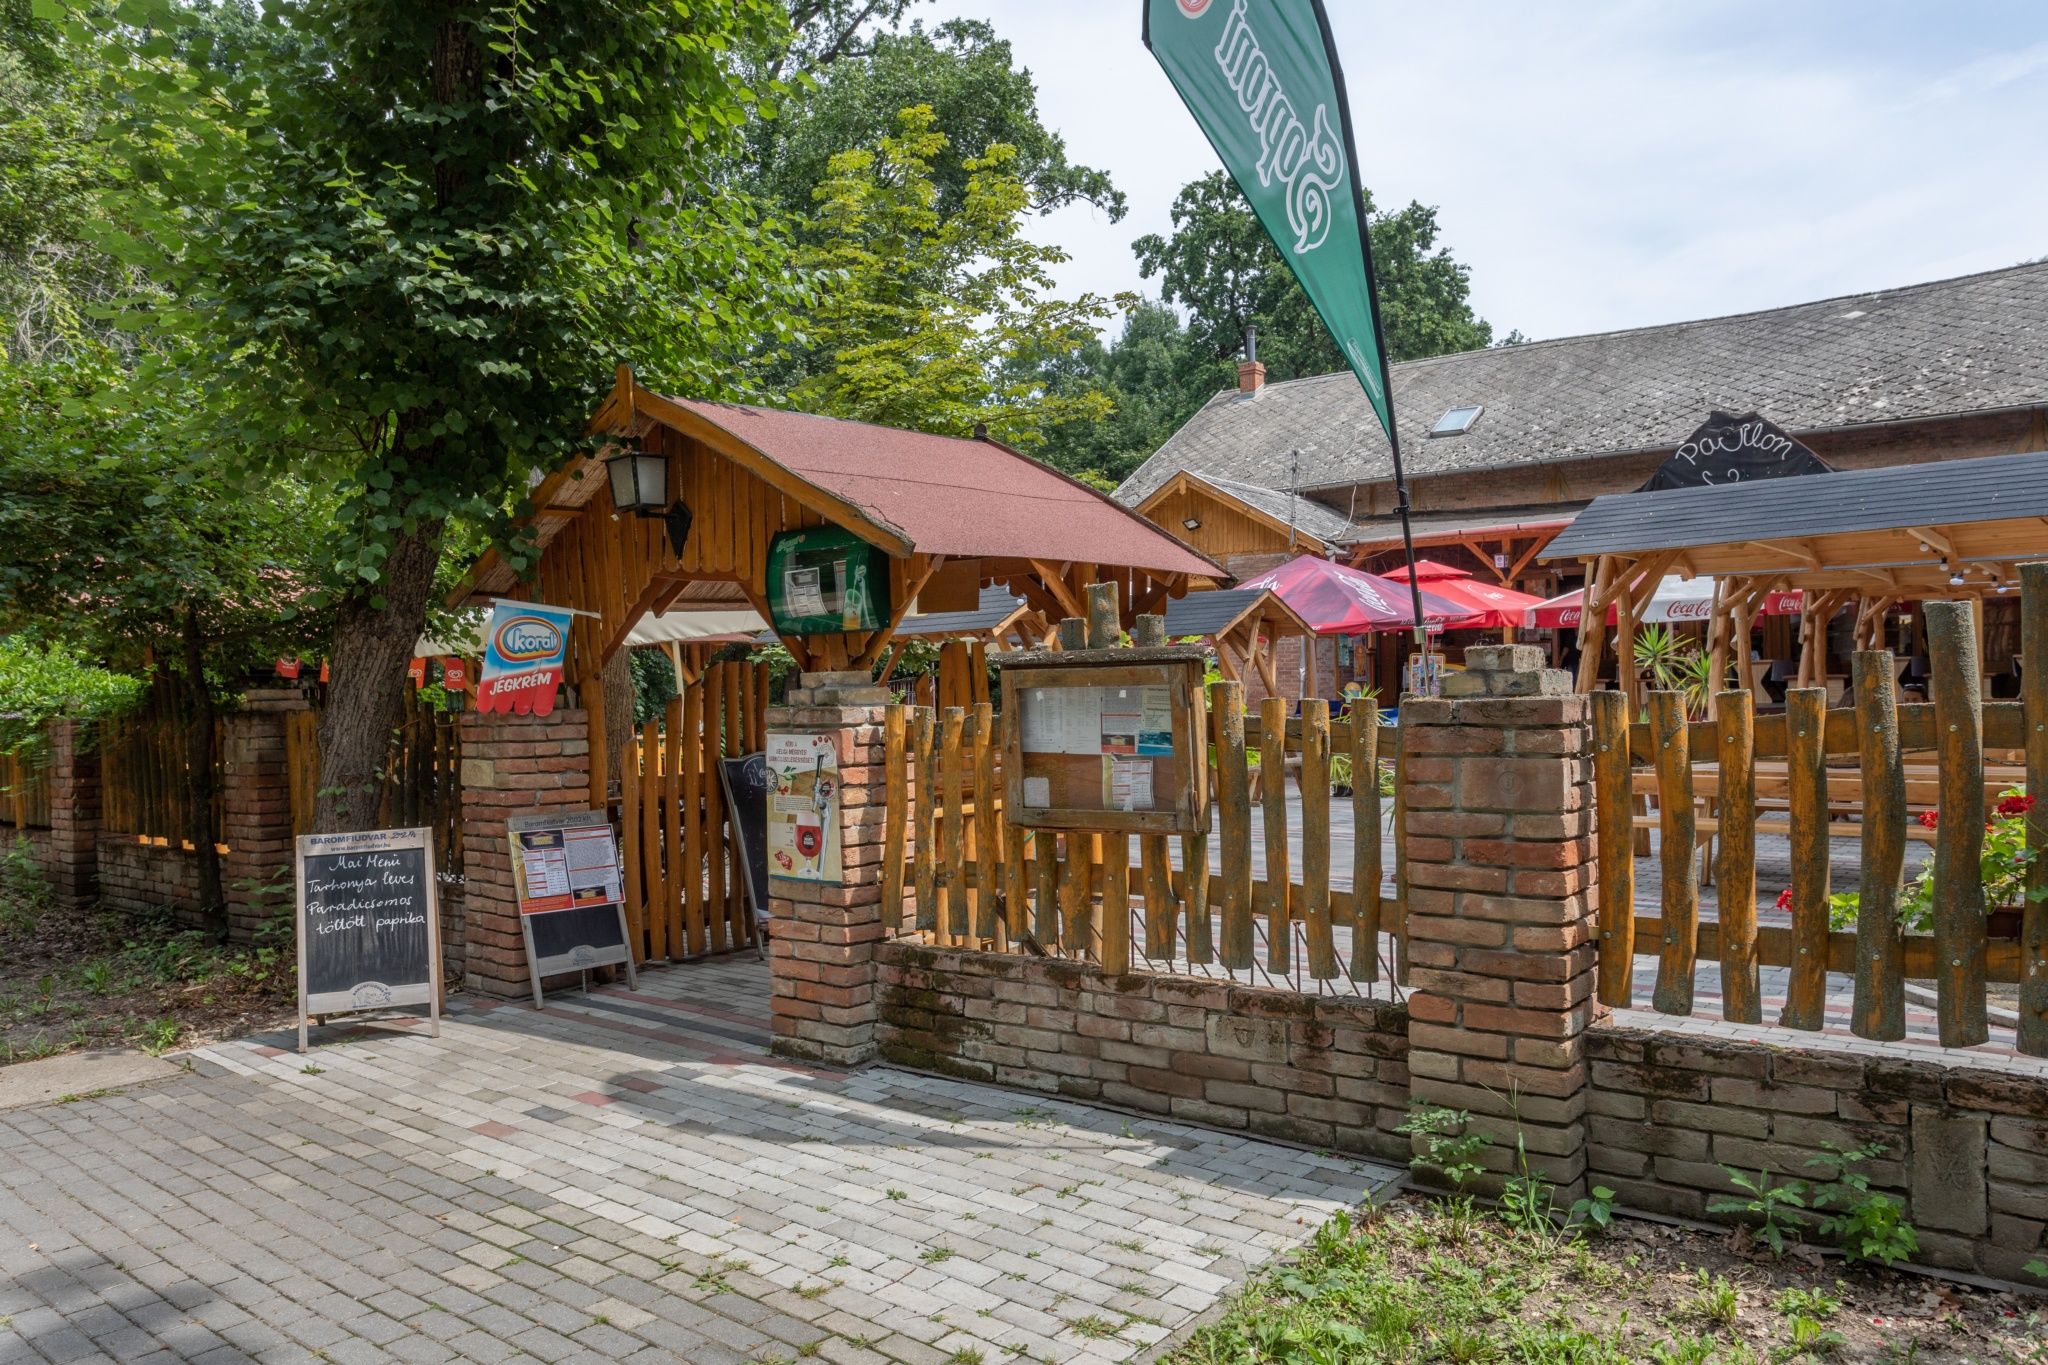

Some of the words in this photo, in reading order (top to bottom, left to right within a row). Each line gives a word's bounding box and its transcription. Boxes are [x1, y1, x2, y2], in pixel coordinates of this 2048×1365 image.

[1559, 608, 1581, 626] Coca
[1666, 599, 1711, 618] Coca-Co
[489, 670, 553, 696] JÉGKRÉM
[310, 833, 387, 845] BAROMFIUDVAR
[329, 856, 362, 871] Mai
[366, 854, 401, 868] Menü
[307, 878, 377, 893] Tarhonya
[382, 871, 415, 885] leves
[306, 896, 413, 915] Paradicsomos
[376, 912, 426, 933] paprika
